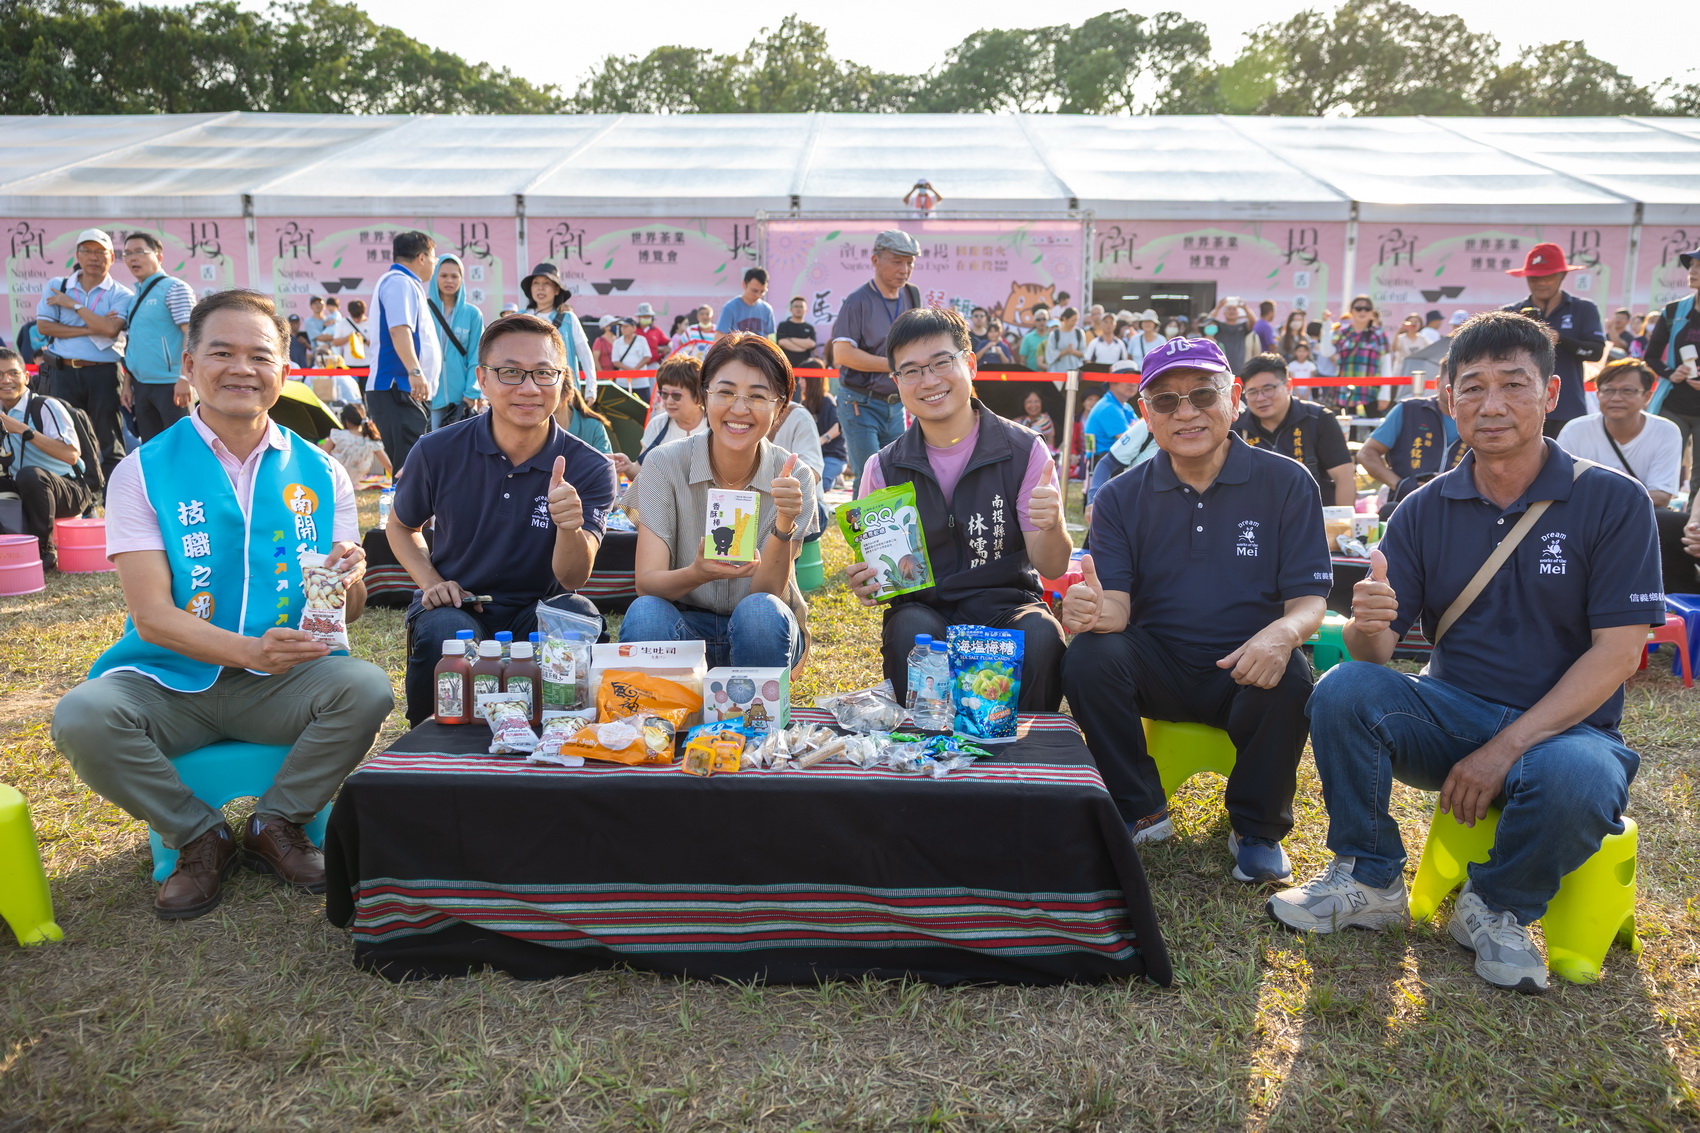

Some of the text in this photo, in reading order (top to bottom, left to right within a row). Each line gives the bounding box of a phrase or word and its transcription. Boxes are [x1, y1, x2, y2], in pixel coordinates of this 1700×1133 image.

[631, 231, 685, 243] 世界茶業
[1184, 236, 1238, 248] 世界茶業
[1465, 238, 1520, 250] 世界茶業
[638, 250, 678, 262] 博覽會
[1189, 255, 1231, 267] 博覽會
[1471, 257, 1512, 269] 博覽會
[864, 507, 895, 527] QQ
[531, 519, 549, 529] Mei
[1237, 520, 1260, 528] Dream
[1540, 531, 1567, 542] Dream
[1236, 547, 1258, 556] Mei
[177, 500, 213, 620] 技職之光
[1539, 563, 1566, 575] Mei
[641, 646, 676, 655] 生吐司
